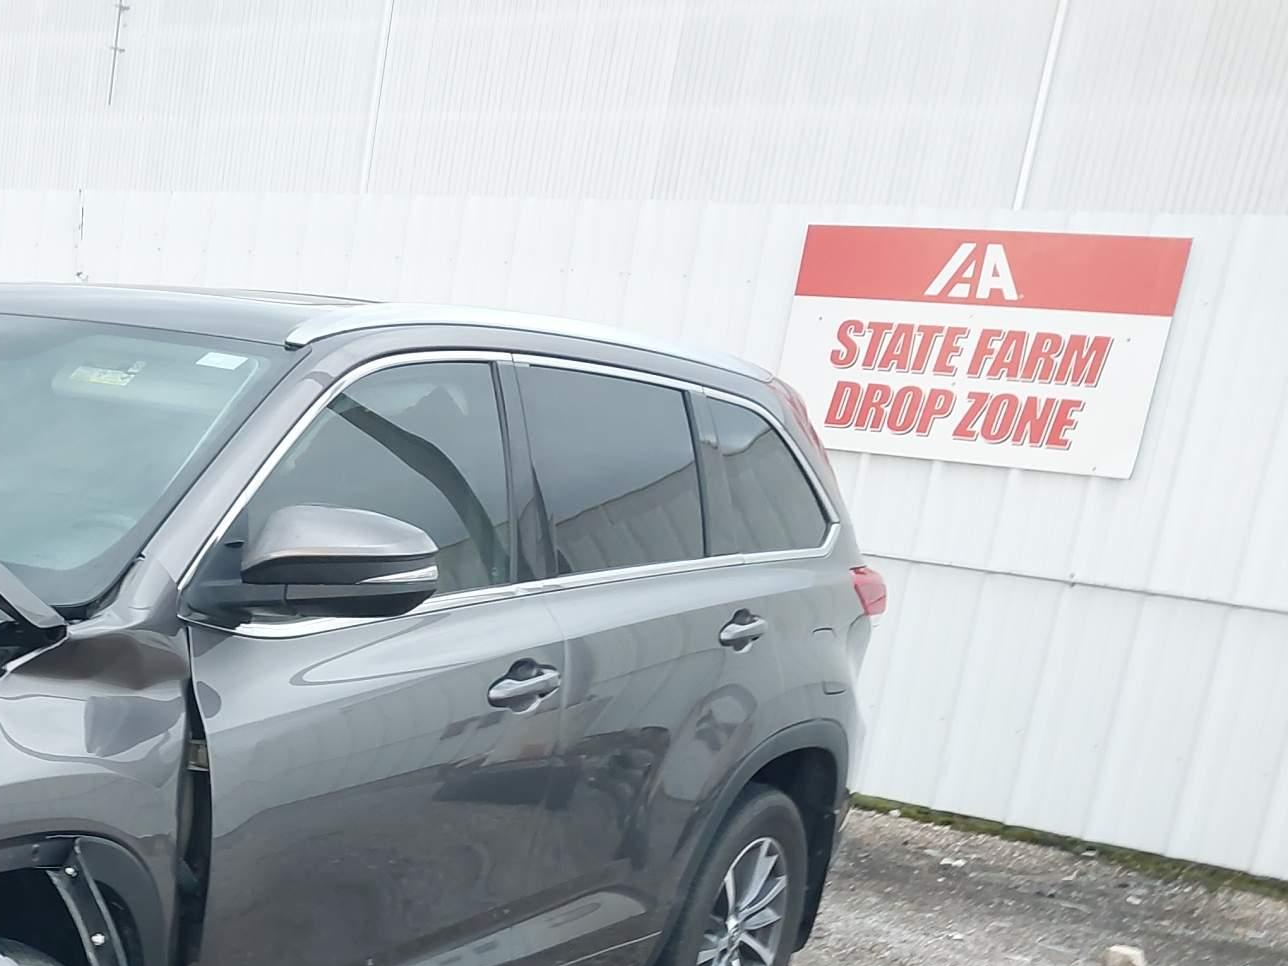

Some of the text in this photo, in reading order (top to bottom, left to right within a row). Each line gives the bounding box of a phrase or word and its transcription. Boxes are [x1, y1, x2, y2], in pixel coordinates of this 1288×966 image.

[829, 319, 1115, 388] STATE FARM
[824, 380, 1085, 450] DROP ZONE
